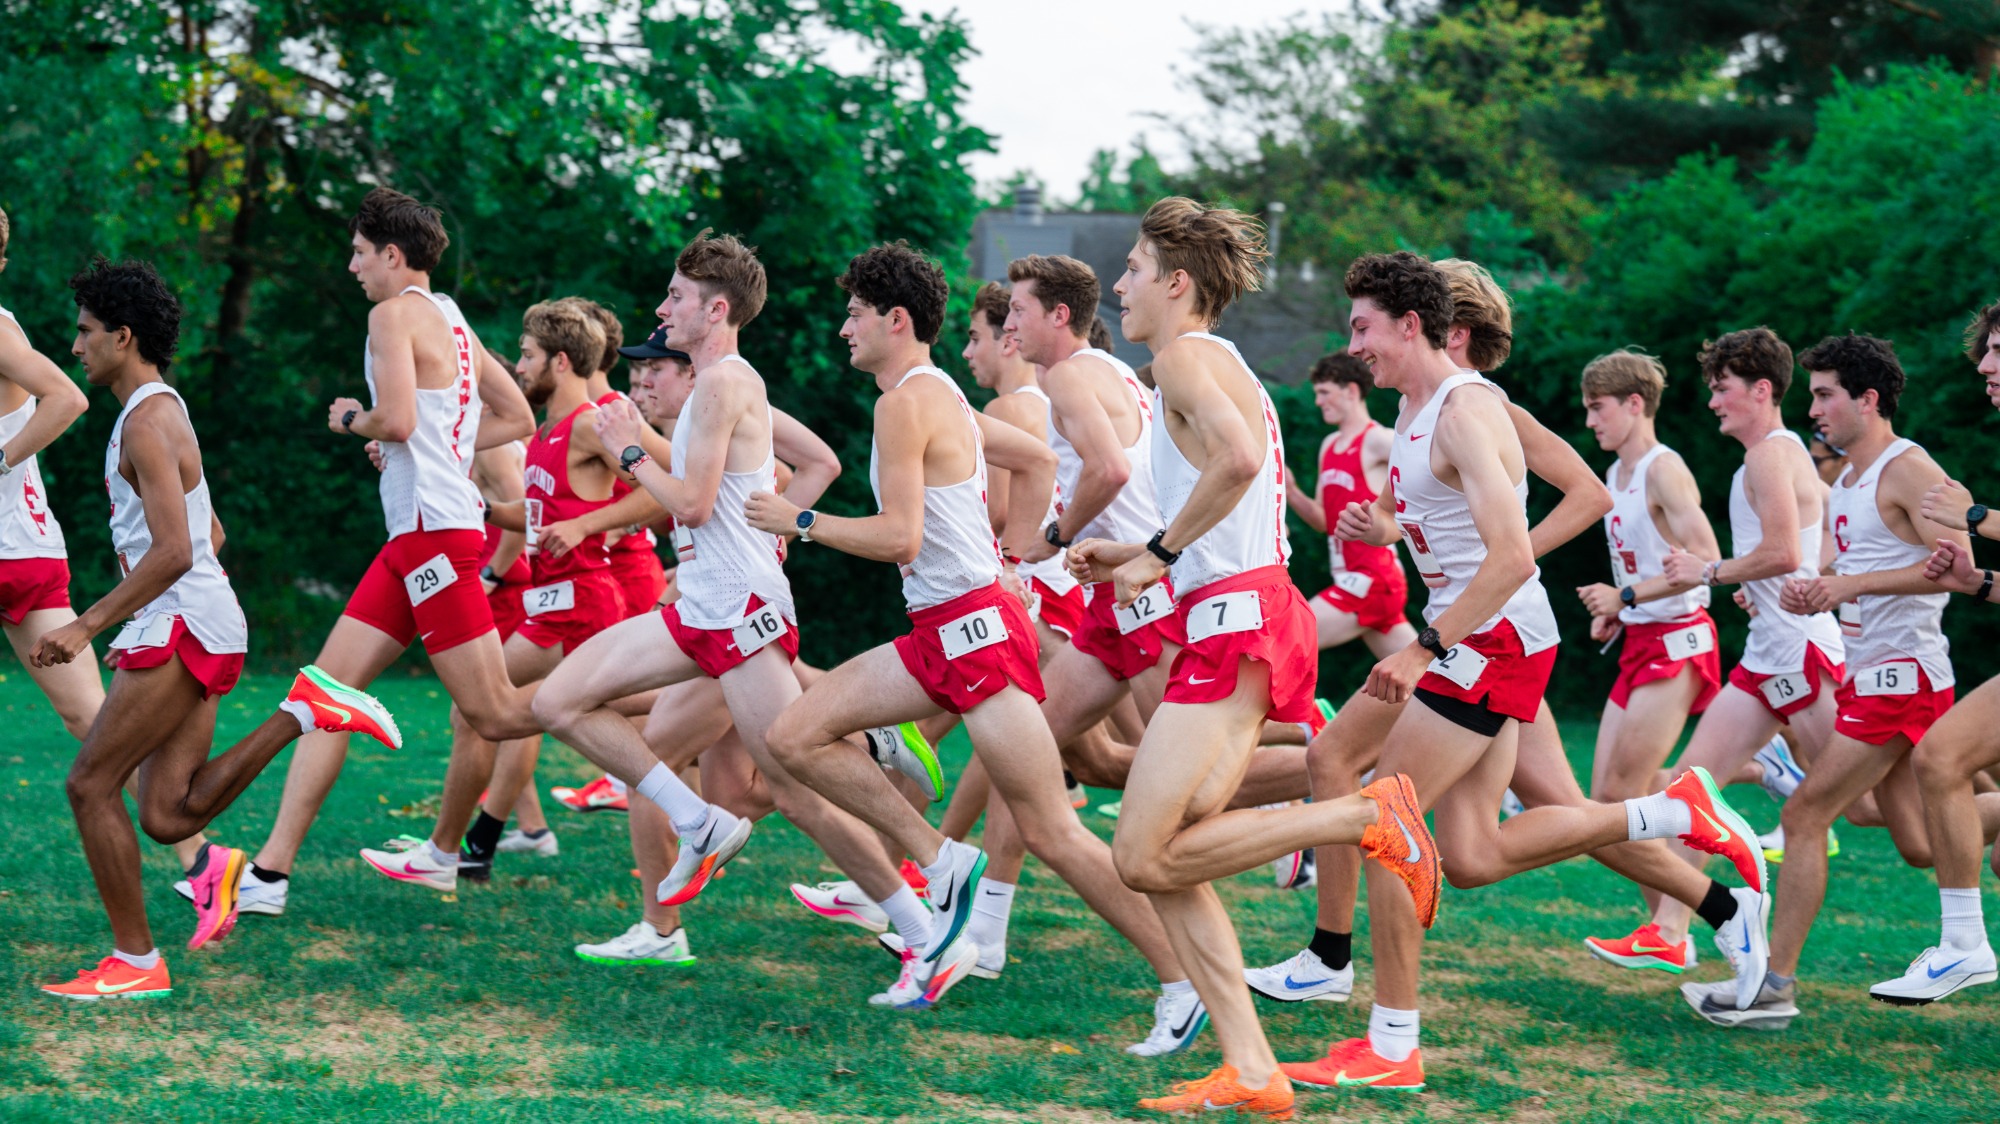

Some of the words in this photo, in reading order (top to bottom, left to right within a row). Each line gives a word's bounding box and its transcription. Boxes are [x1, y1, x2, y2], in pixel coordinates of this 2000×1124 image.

[1611, 515, 1624, 549] C
[1835, 515, 1851, 552] C
[414, 568, 439, 593] 29
[538, 589, 559, 607] 27
[1128, 595, 1156, 620] 12
[749, 611, 778, 639] 16
[1211, 601, 1228, 626] 7
[960, 617, 989, 644] 10
[1686, 632, 1698, 649] 9
[1774, 678, 1794, 699] 13
[1874, 668, 1898, 688] 15
